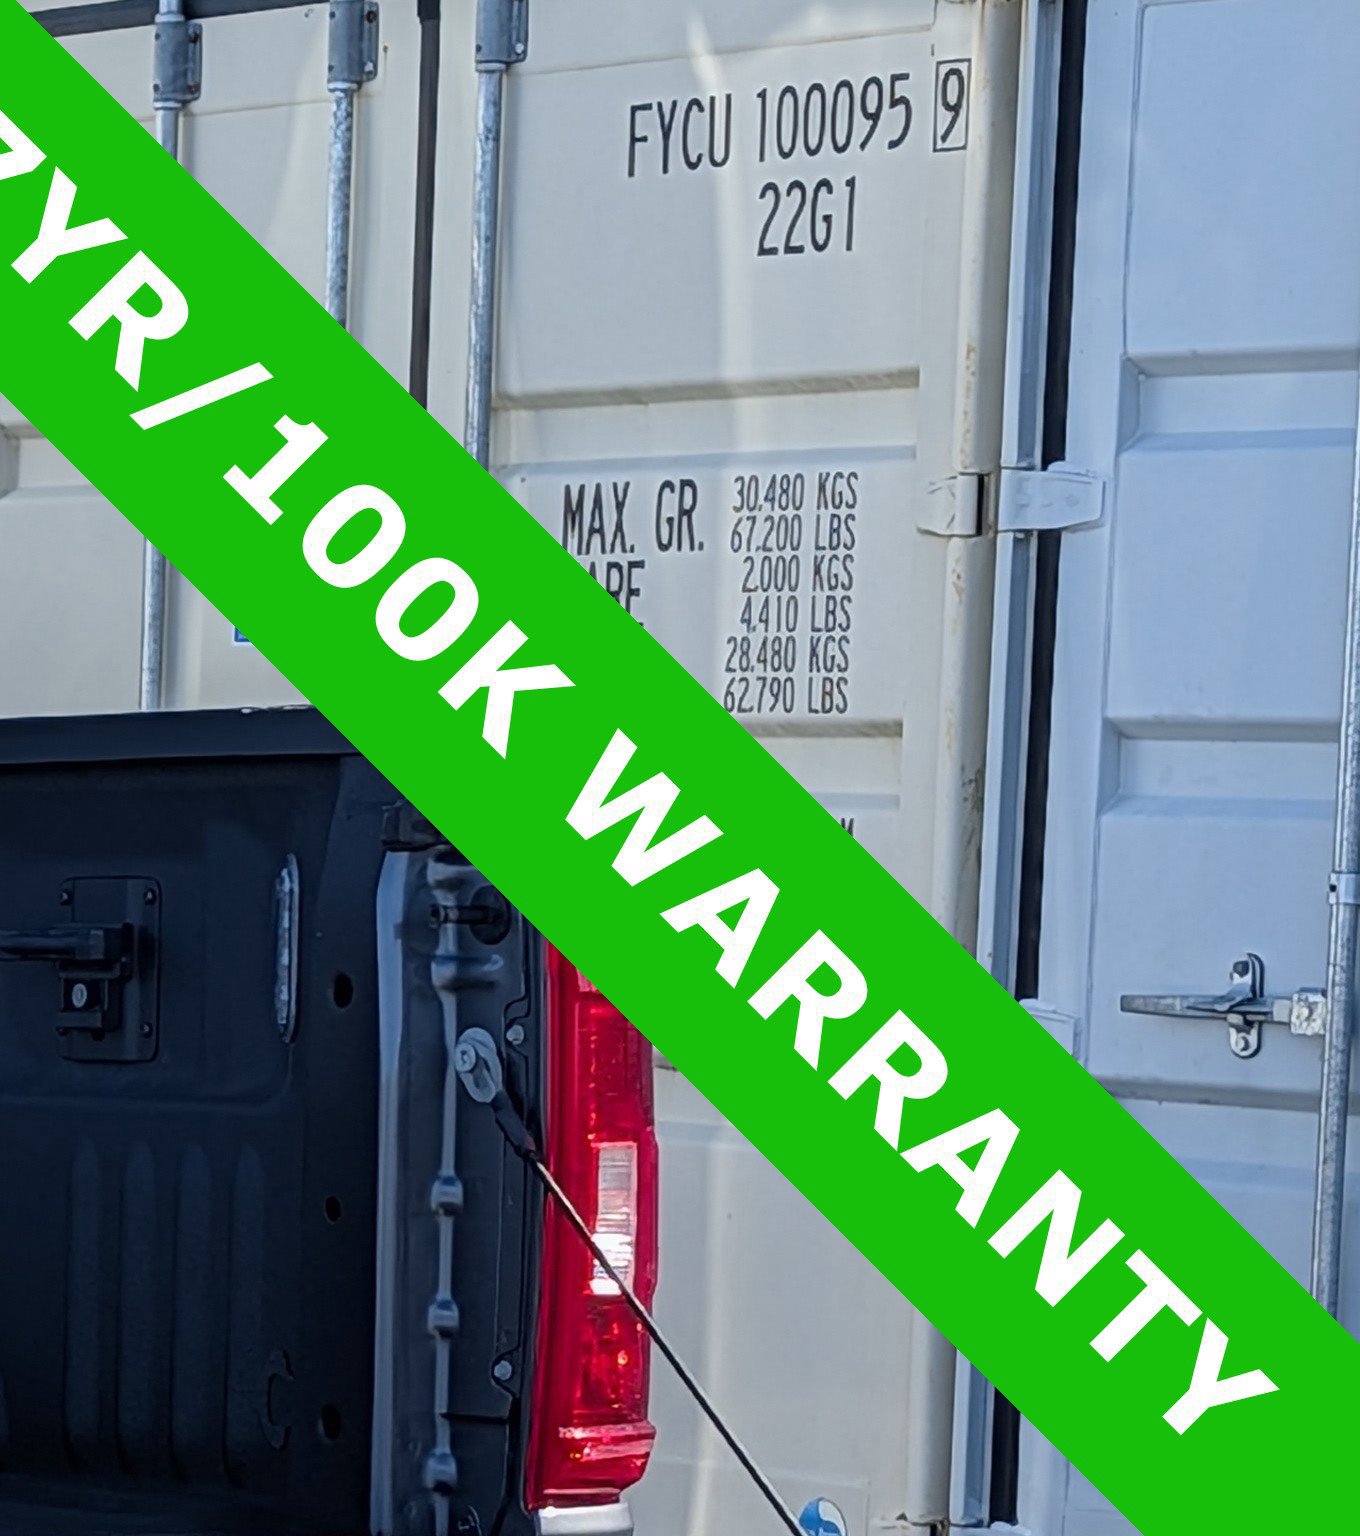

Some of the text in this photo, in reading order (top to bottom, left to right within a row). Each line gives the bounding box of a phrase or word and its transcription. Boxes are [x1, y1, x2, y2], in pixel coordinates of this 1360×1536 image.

[628, 65, 968, 178] FYCU 100095 9
[757, 175, 857, 257] 22G1
[732, 471, 859, 513] 30.480 KGS
[561, 478, 704, 556] MAX. GR.
[729, 513, 857, 553] 67.200 LBS
[812, 553, 855, 592] KGS
[739, 595, 852, 633] 4.410 LBS
[724, 635, 851, 674] 28.480 KGS
[806, 675, 849, 715] LBS
